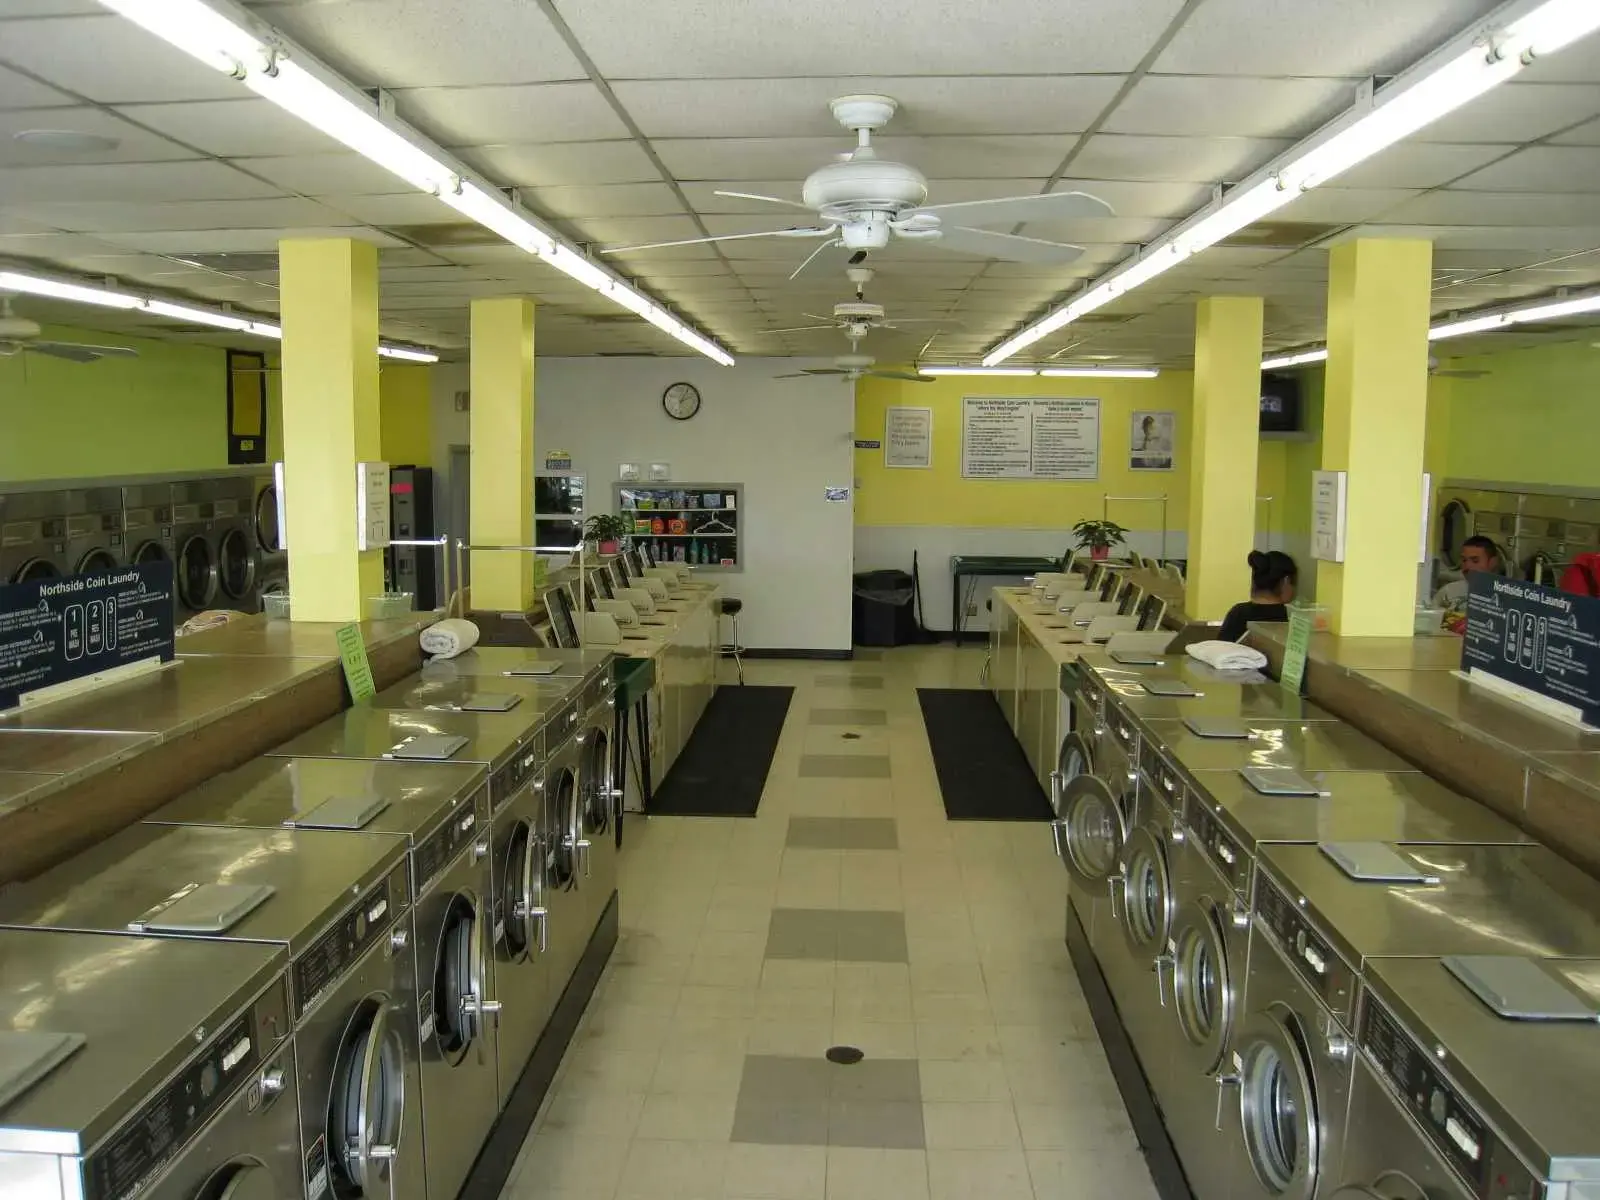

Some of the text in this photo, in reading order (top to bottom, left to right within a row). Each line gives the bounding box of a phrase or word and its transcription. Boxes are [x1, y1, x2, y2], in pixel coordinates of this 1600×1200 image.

[40, 571, 140, 597] Northside Coin Laundry
[1493, 580, 1572, 613] Northside Coin Laundry
[92, 605, 98, 618] 2
[108, 601, 114, 614] 3
[71, 609, 76, 622] 1
[1512, 614, 1516, 626] 1
[1526, 618, 1533, 631] 2
[1539, 622, 1545, 635] 3
